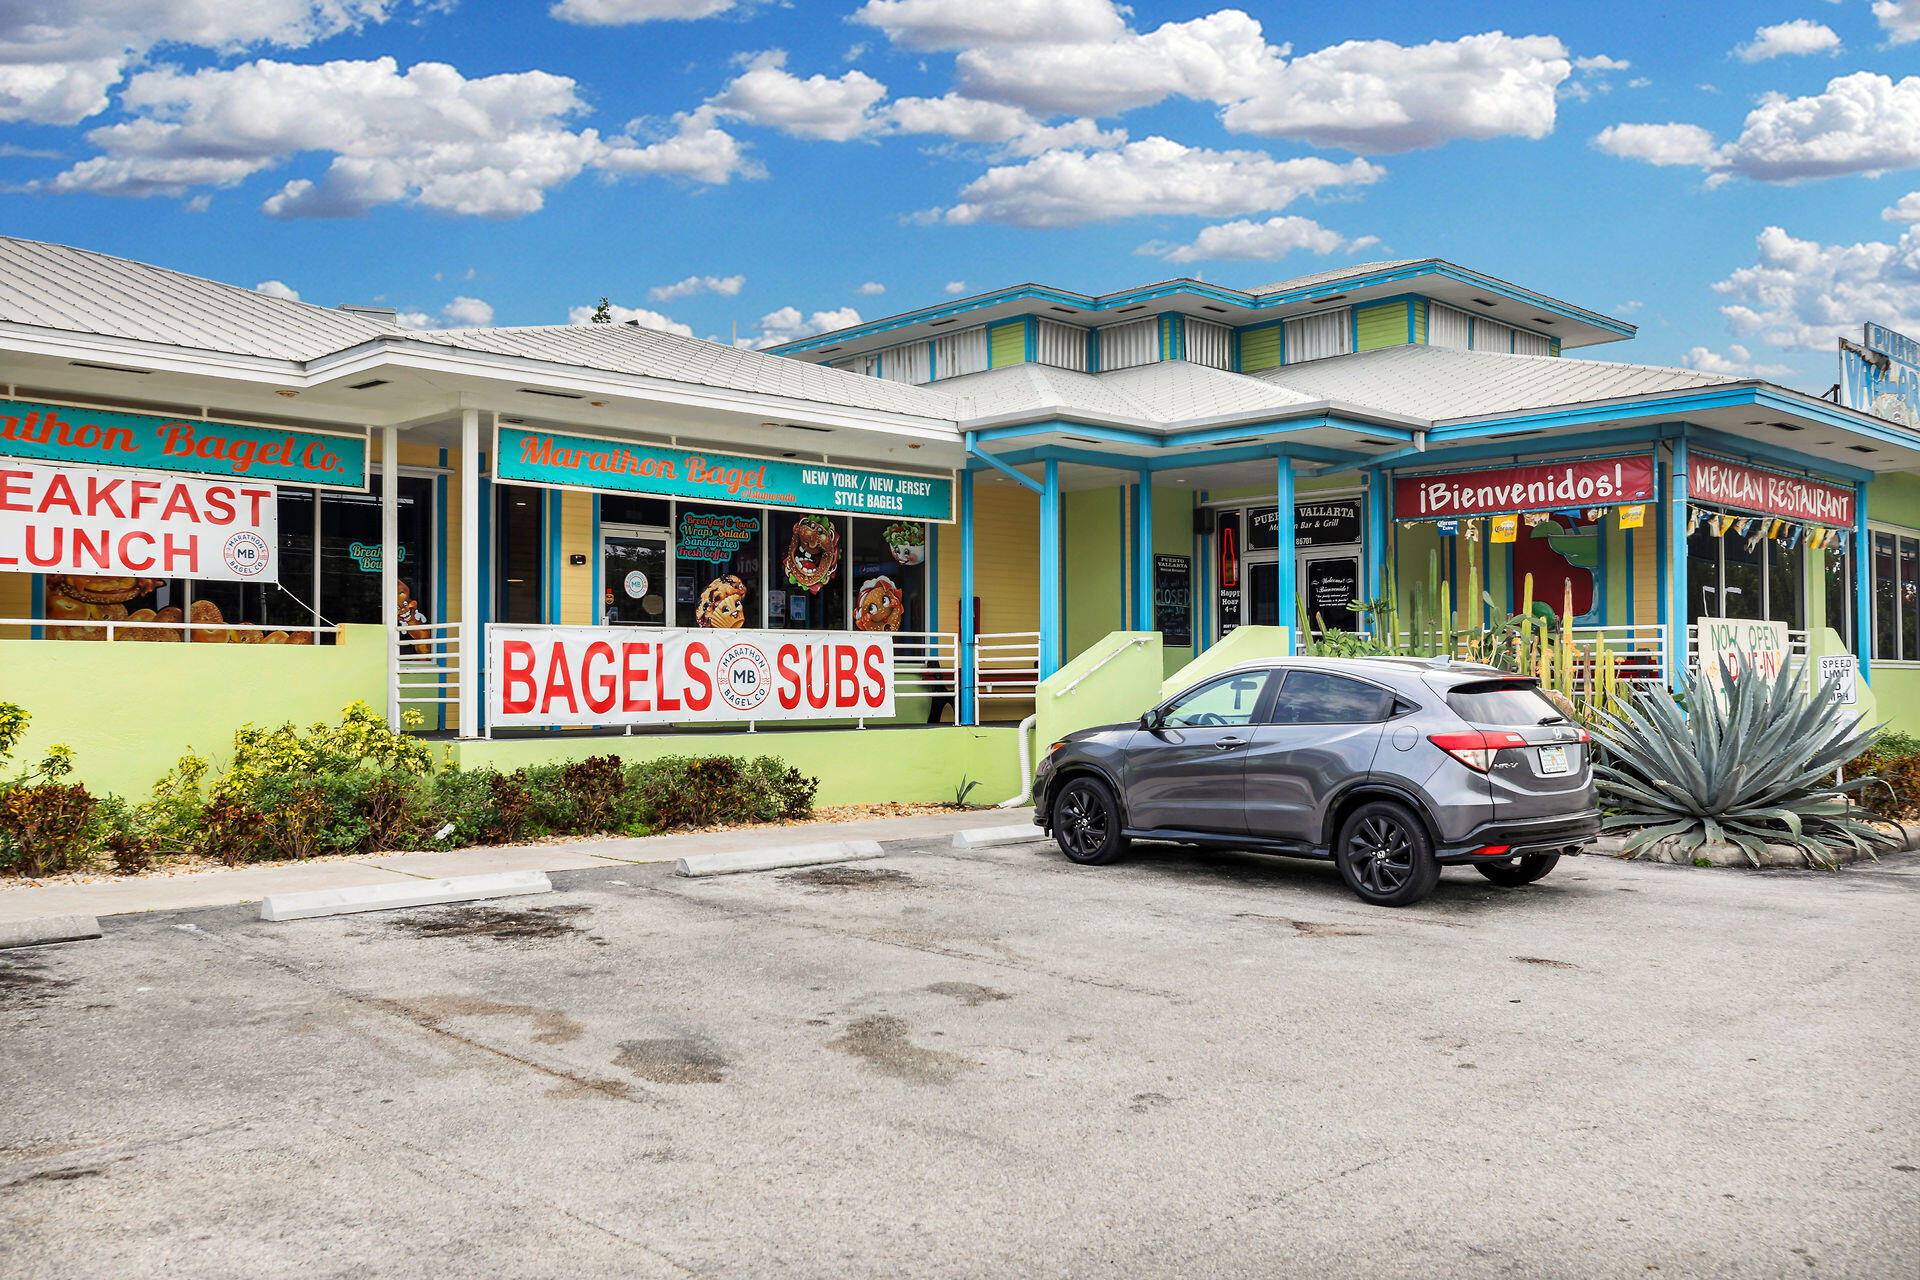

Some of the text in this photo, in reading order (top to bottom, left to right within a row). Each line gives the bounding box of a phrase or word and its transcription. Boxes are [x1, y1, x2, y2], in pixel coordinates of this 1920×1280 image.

[156, 422, 296, 472] Bagel
[302, 441, 345, 474] Co.
[519, 435, 766, 494] Marathon Bagel
[802, 469, 830, 486] NEW
[831, 473, 858, 489] YORK
[869, 476, 894, 492] NEW
[895, 479, 931, 496] JERSEY
[1420, 463, 1622, 513] ¡Bienvenidos!
[741, 488, 797, 502] @Islamorada
[1696, 464, 1849, 522] MEXICAN RESTAURANT
[834, 491, 903, 511] STYLE BAGELS
[1299, 506, 1355, 518] VALLARTA
[735, 519, 758, 530] Lunch
[1300, 521, 1313, 529] Bar
[1314, 520, 1321, 528] &
[1323, 518, 1339, 528] Grill
[682, 525, 749, 540] Wraps Salads
[229, 534, 264, 549] MARATHON
[684, 536, 738, 549] Sandwiches
[237, 549, 255, 559] MB
[677, 546, 702, 557] Fresh
[230, 560, 253, 573] BAGEL
[1710, 624, 1780, 651] NOW OPEN
[722, 647, 766, 669] MARATHON
[1822, 659, 1852, 668] SPEED
[502, 640, 886, 715] BAGELS SUBS
[733, 669, 757, 684] MB
[724, 688, 766, 707] BAGEL CO
